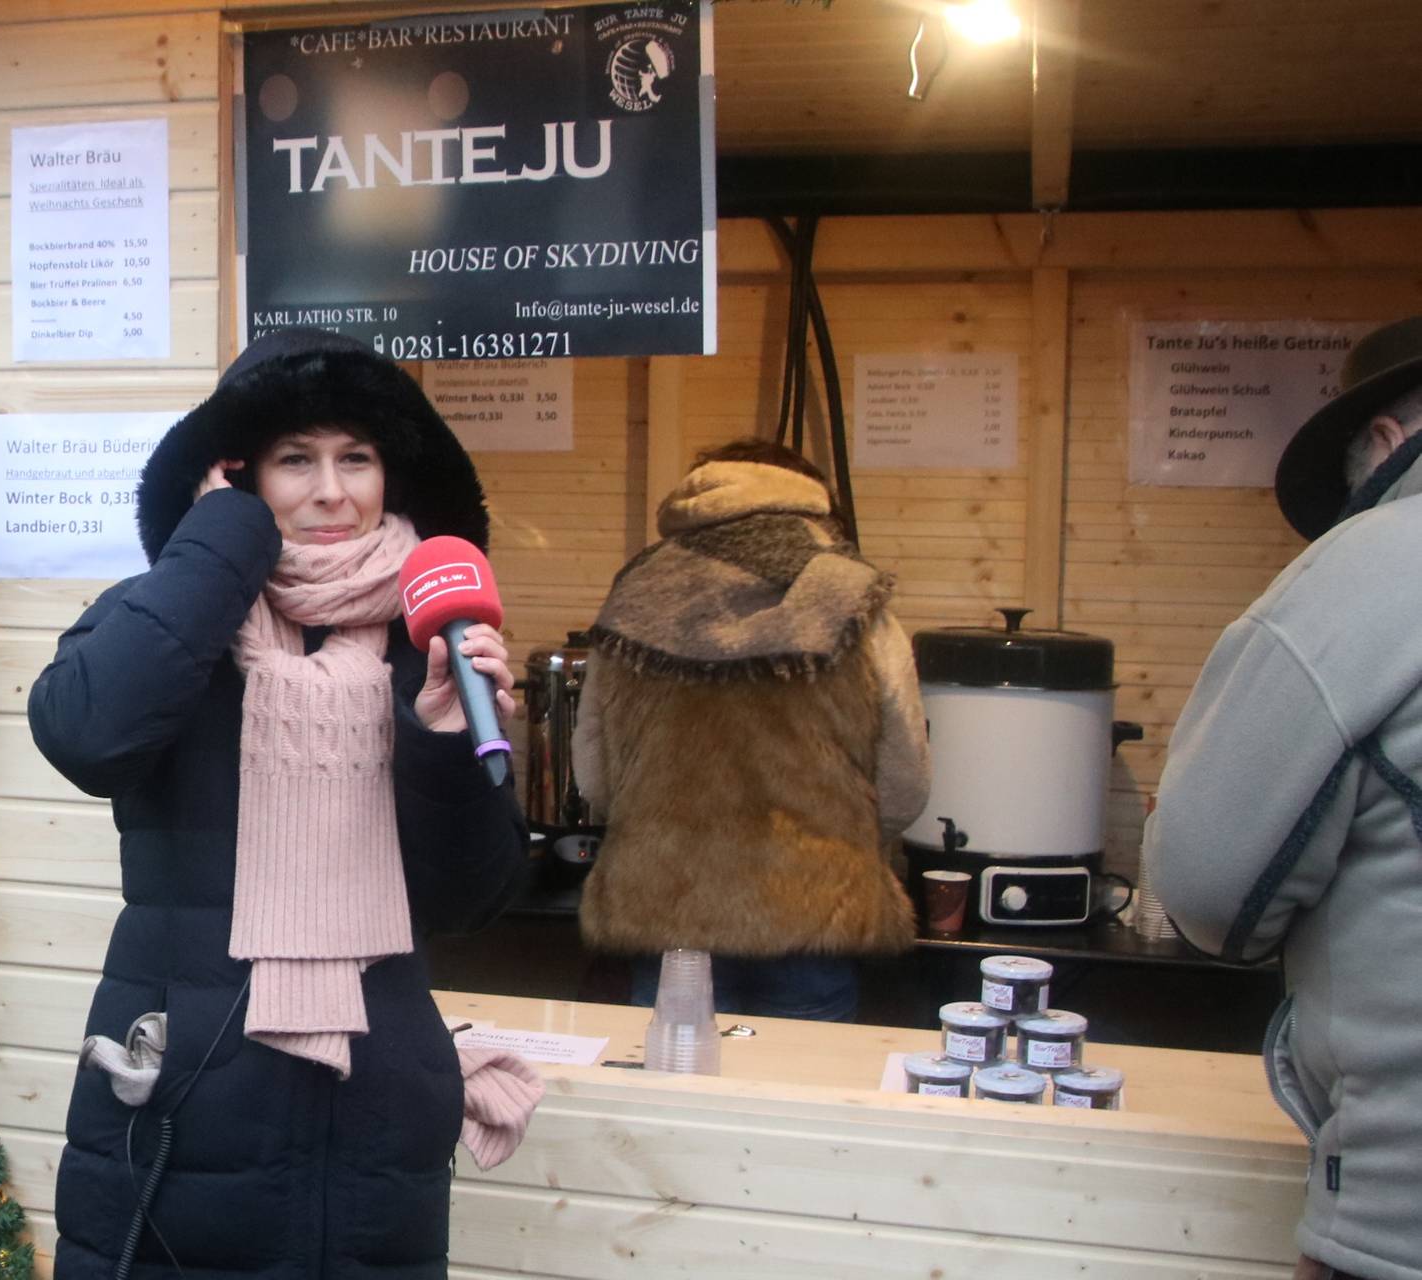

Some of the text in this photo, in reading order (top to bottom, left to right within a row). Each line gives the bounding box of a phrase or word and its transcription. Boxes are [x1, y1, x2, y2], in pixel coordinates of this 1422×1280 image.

[594, 8, 687, 31] ZUR TANTE JU
[609, 88, 653, 111] WESEL
[30, 149, 122, 168] Walter Bräu
[273, 120, 613, 193] TANTE JU
[28, 195, 144, 210] Weihnachts Geschenk
[29, 241, 94, 251] Bockbierbrand
[97, 239, 115, 248] 40%
[124, 257, 150, 268] 10,50
[408, 239, 699, 273] HOUSE OF SKYDIVING
[82, 279, 117, 288] Pralinen
[31, 299, 67, 308] Bockbier
[82, 298, 106, 306] Beere
[515, 297, 699, 320] Info@tante-ju-wesel.de
[123, 311, 142, 321] 4,50
[253, 307, 397, 326] KARL JATHO STR. 10
[31, 328, 142, 340] Dinkelbier Dip 5,00
[391, 331, 571, 359] 0281-16381271
[1147, 336, 1193, 350] Tante
[1233, 336, 1278, 350] heiße
[1284, 336, 1352, 350] Getränk
[1171, 362, 1230, 374] Glühwein
[435, 393, 468, 402] Winter
[472, 393, 494, 402] Bock
[1170, 384, 1339, 398] Glühwein Schuß 4,5
[1170, 406, 1227, 419] Bratapfel
[1169, 428, 1253, 442] Kinderpunsch
[6, 438, 160, 454] Walter Bräu Büderic
[1167, 449, 1206, 462] Kakao
[6, 468, 71, 480] Handgebraut
[78, 468, 96, 479] und
[6, 491, 54, 504] Winter
[59, 491, 93, 504] Bock
[6, 520, 103, 535] Landbier 0,33l
[412, 574, 466, 600] radio k.w.
